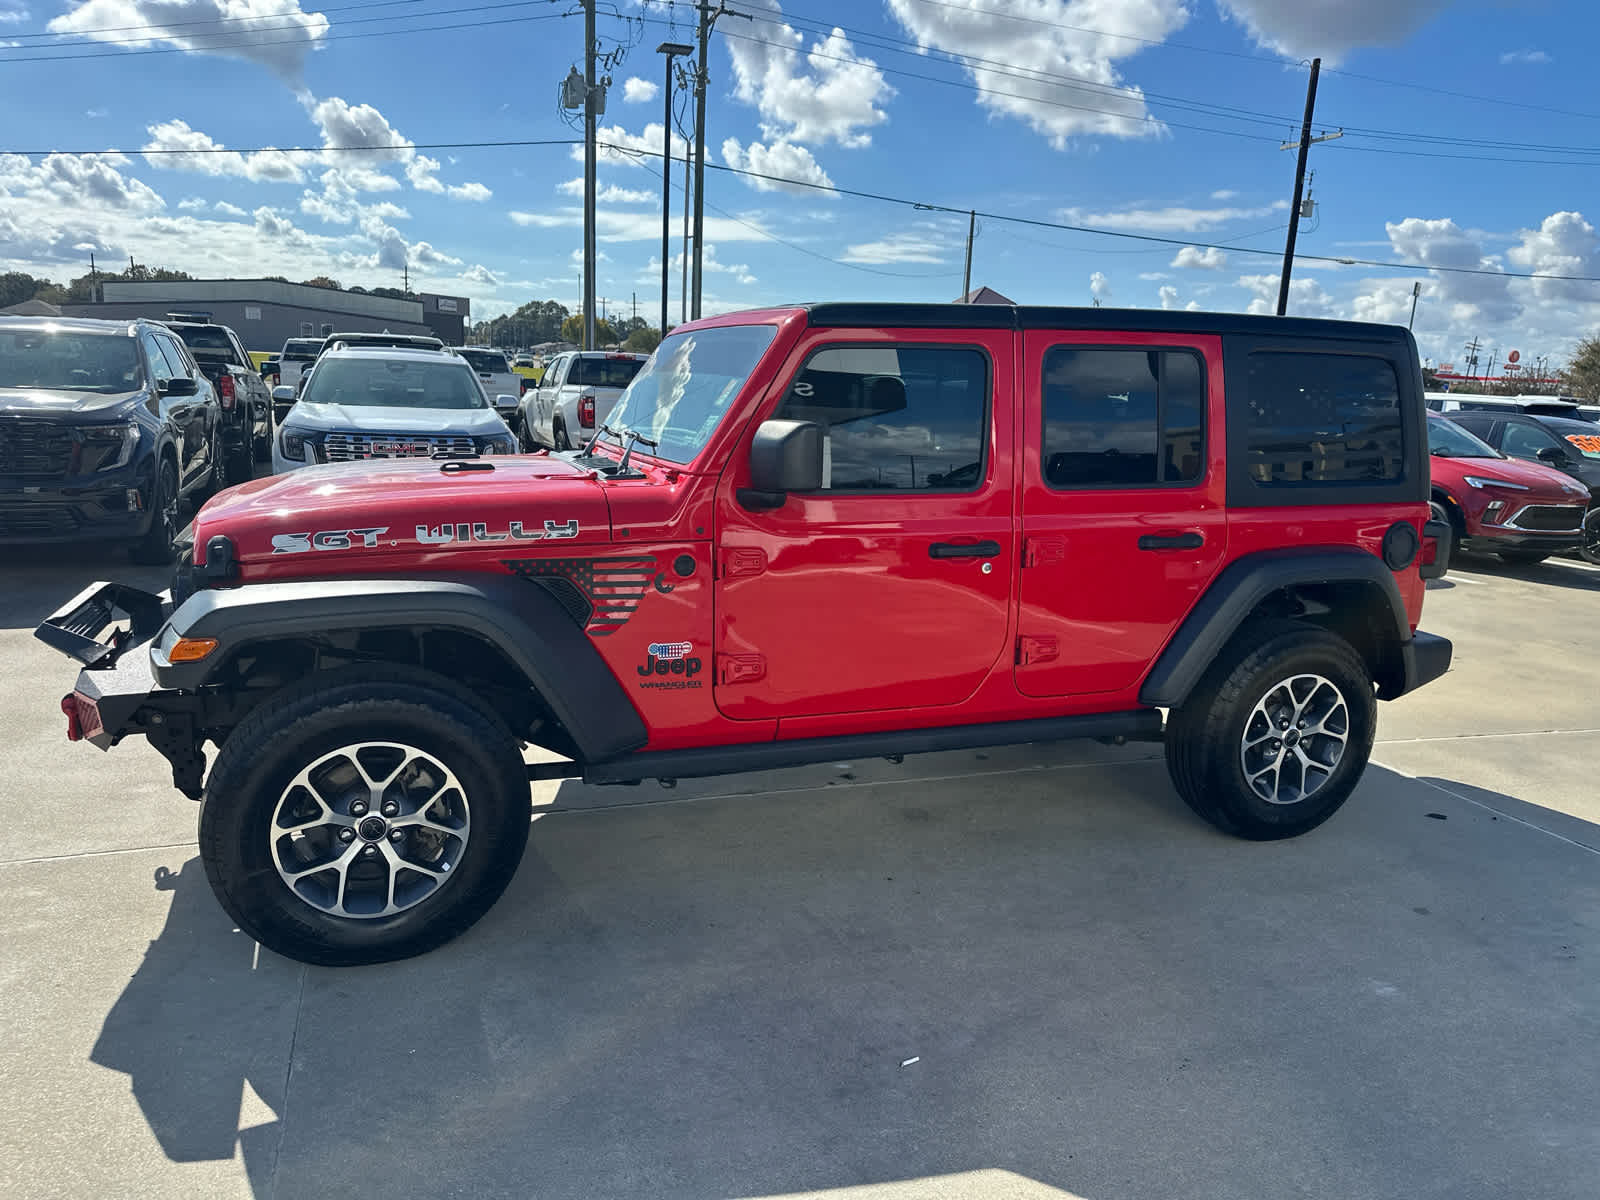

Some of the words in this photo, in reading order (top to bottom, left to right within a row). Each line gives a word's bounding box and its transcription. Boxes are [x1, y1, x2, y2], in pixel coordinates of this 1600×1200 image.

[373, 442, 428, 453] GMC
[271, 526, 398, 555] SGT.
[415, 519, 580, 545] WILLY
[637, 654, 702, 677] Jeep
